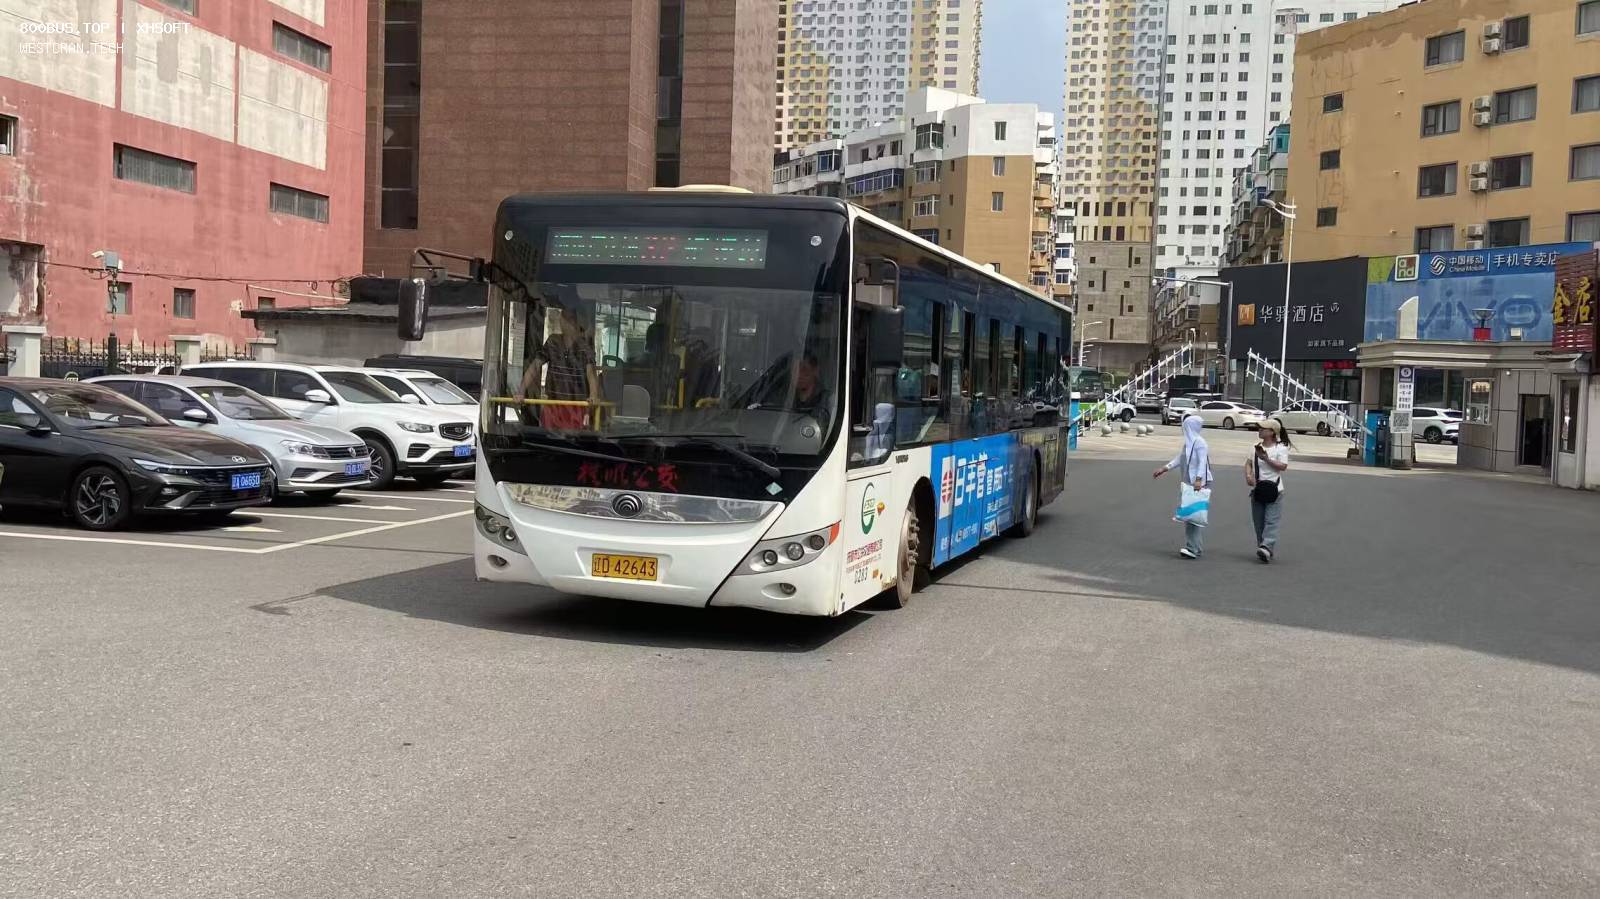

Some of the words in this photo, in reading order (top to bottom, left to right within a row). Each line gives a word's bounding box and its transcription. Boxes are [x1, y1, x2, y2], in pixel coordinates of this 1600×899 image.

[1449, 255, 1484, 265] 中国移动
[1493, 250, 1560, 267] 手机专卖店
[1260, 304, 1325, 323] 华驿酒店
